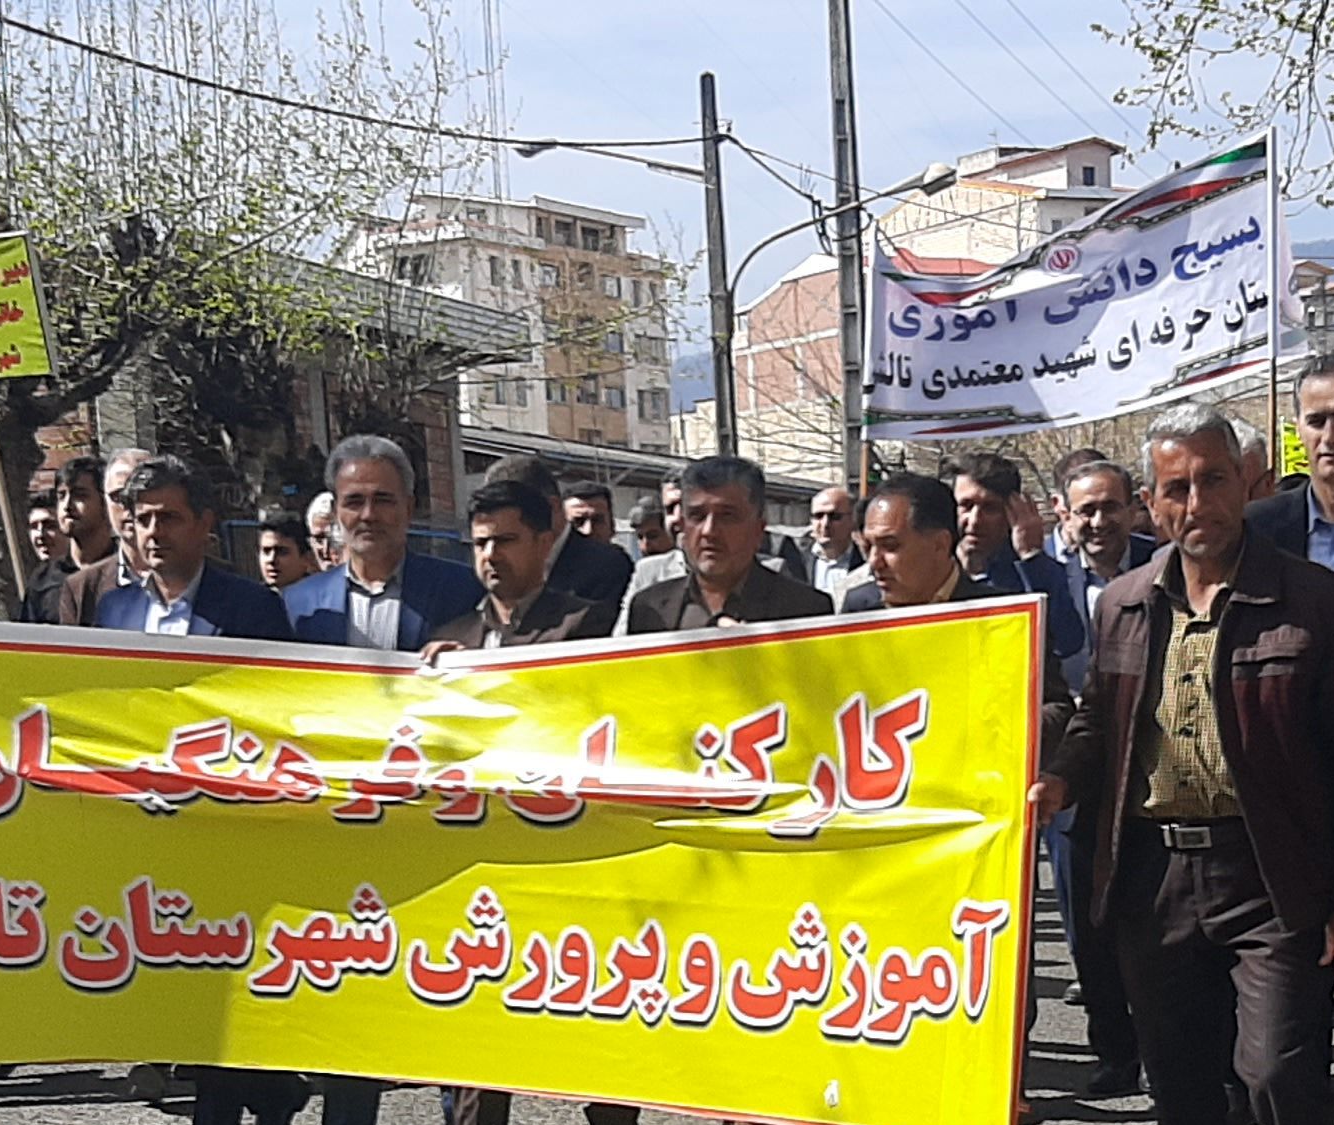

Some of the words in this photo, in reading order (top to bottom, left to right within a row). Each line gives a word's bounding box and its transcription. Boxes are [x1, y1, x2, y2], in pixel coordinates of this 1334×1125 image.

[1170, 215, 1265, 281] بسیج
[1044, 257, 1158, 326] دانش
[1033, 334, 1097, 383] شهید
[1107, 319, 1141, 372] ای
[1150, 305, 1212, 351] حرفه
[921, 359, 1024, 401] معتمدی
[58, 875, 398, 994] شهرستان
[405, 887, 667, 1027] پرورش
[670, 931, 721, 1023] و
[727, 900, 1010, 1045] آموزش
